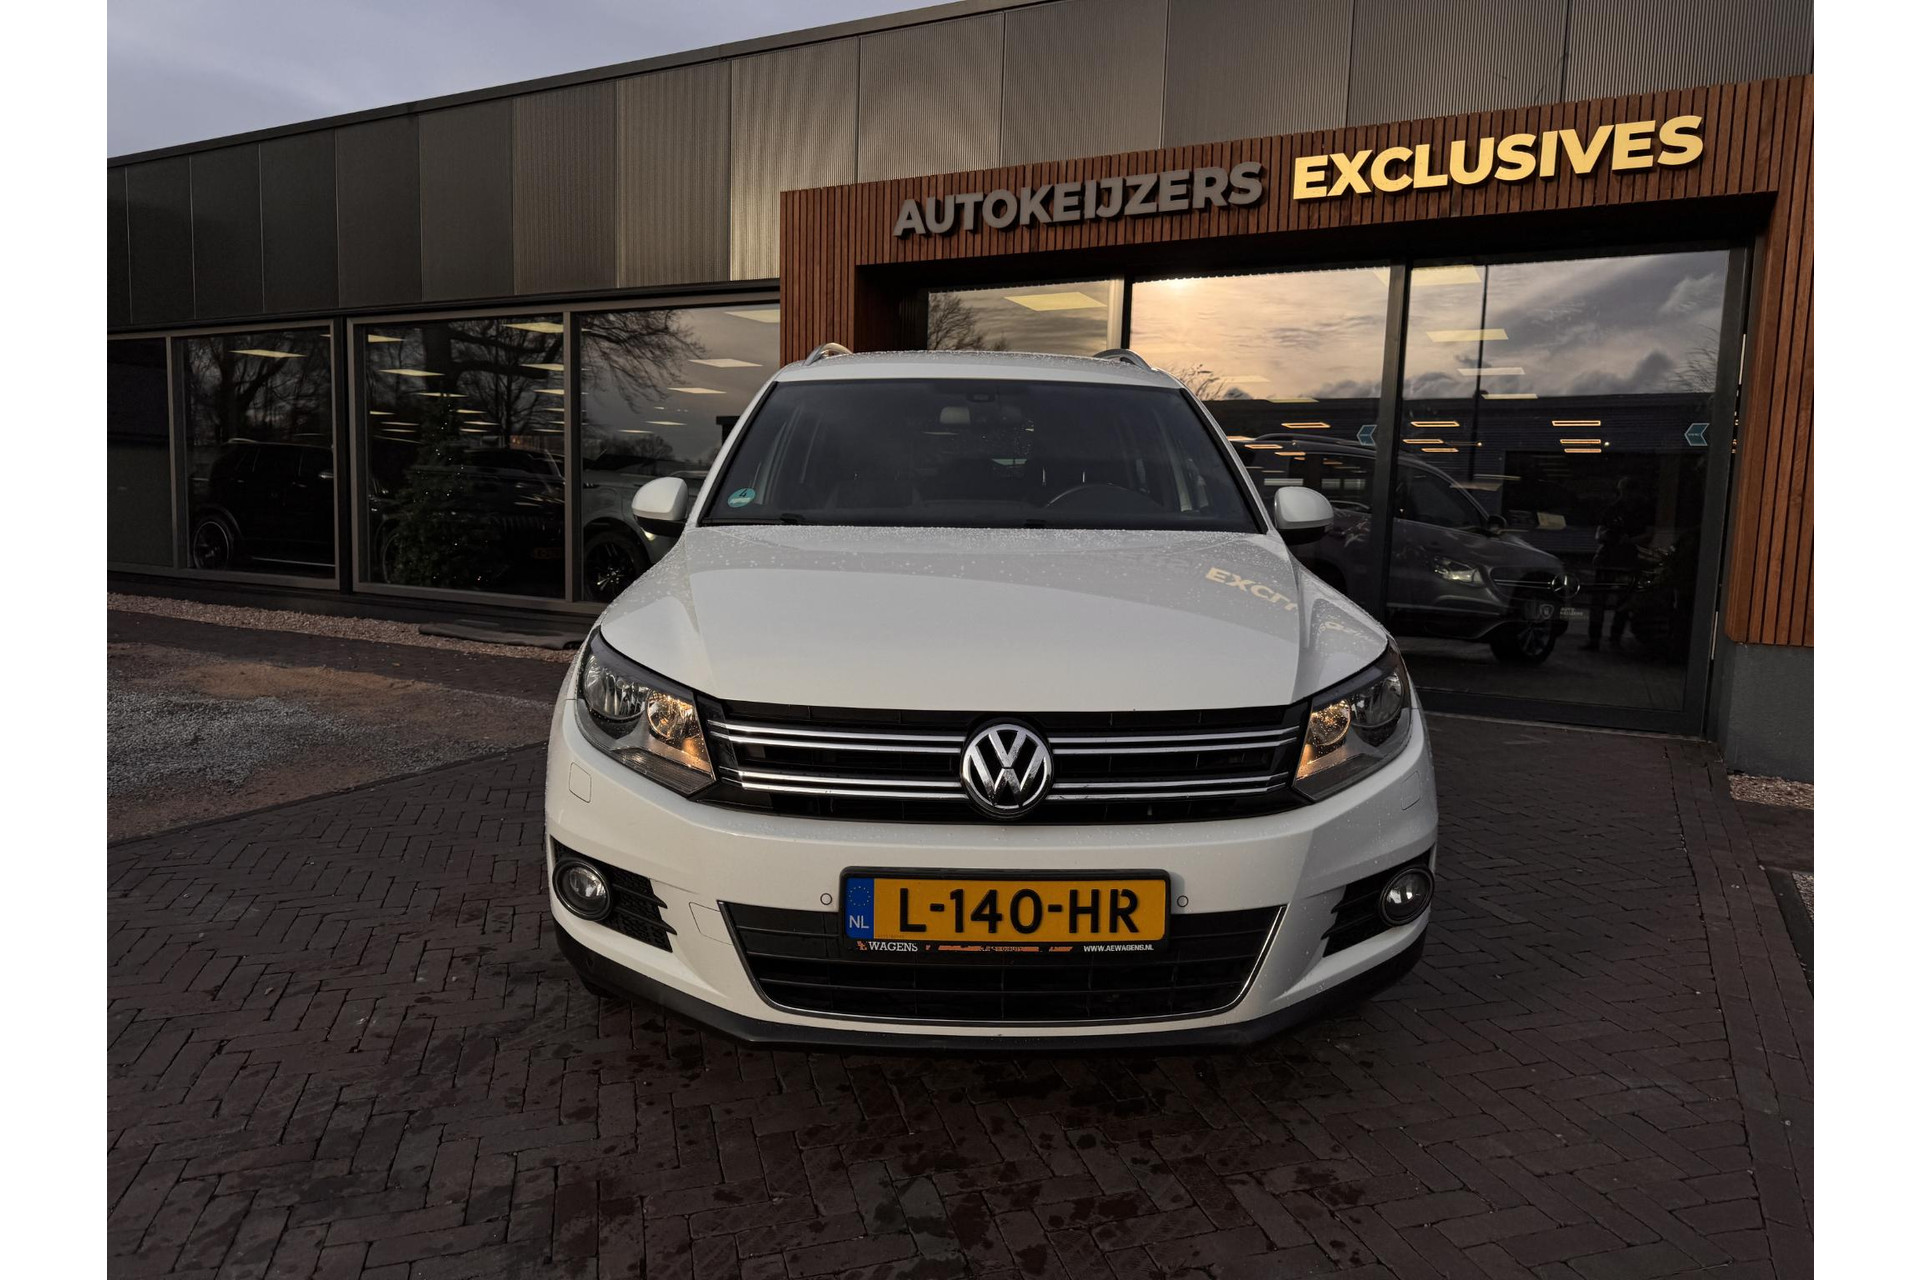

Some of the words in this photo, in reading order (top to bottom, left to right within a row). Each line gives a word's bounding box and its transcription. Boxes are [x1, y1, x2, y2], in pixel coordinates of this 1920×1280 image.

[893, 161, 1264, 238] AUTOKEIJZERS
[1292, 115, 1704, 200] EXCLUSIVES
[849, 914, 869, 929] NL
[899, 888, 1139, 934] L-140-HR
